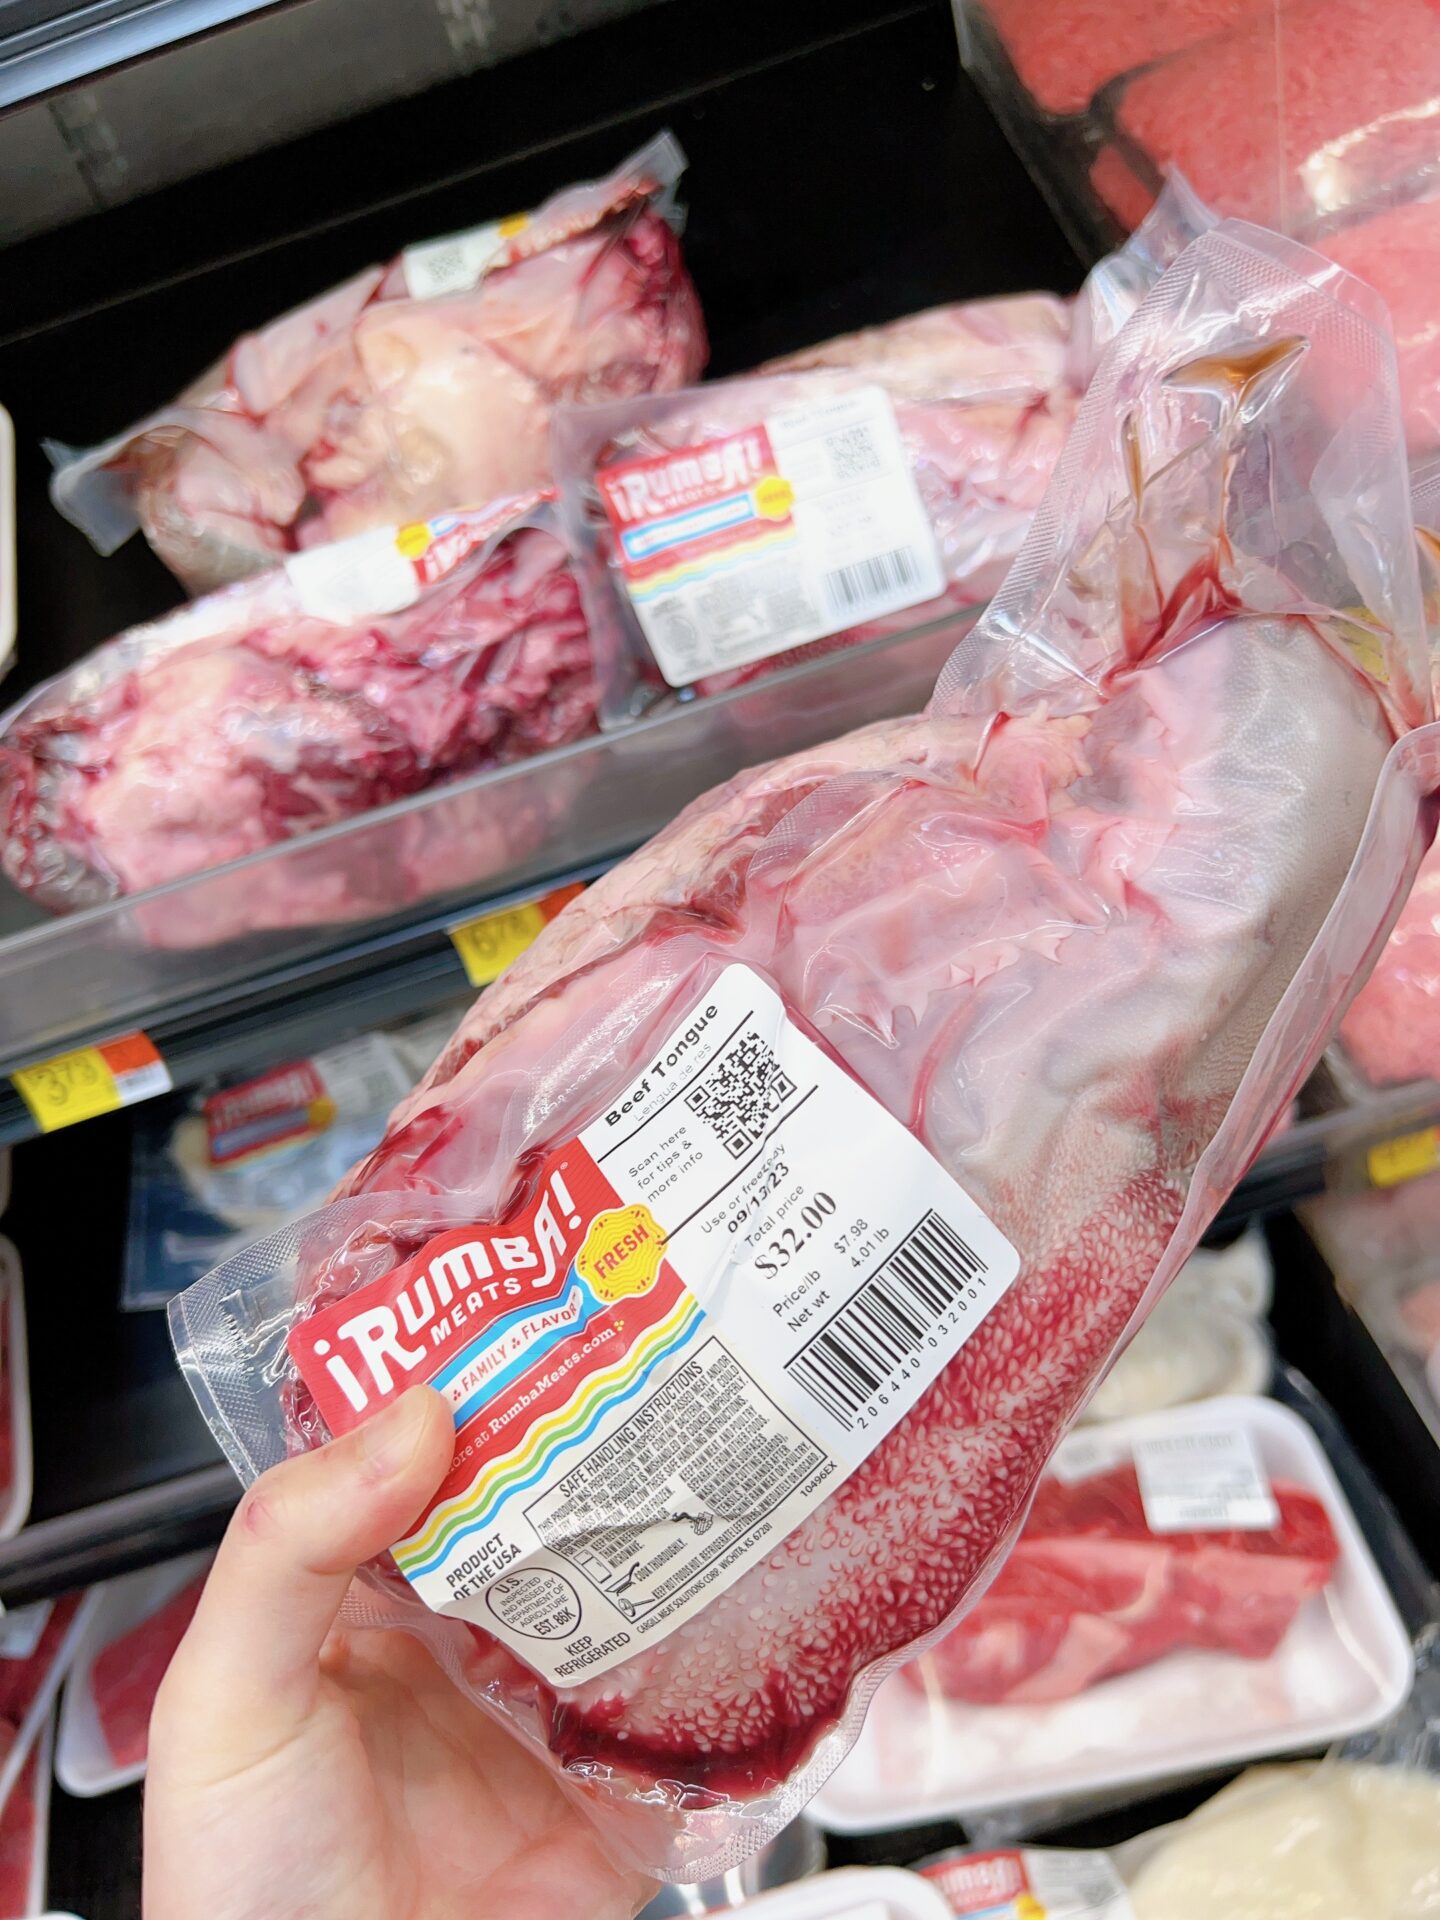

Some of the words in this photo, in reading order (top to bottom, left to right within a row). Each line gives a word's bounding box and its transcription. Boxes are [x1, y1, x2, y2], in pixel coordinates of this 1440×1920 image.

[603, 1079, 653, 1127] Beef
[650, 1003, 719, 1076] Tongue
[633, 1079, 679, 1122] Lengua
[676, 1062, 694, 1082] de
[691, 1042, 712, 1064] res
[627, 1148, 659, 1178] Scan
[658, 1124, 687, 1151] here
[636, 1170, 656, 1189] for
[655, 1148, 681, 1174] tips
[680, 1138, 693, 1150] &
[646, 1172, 679, 1202] more
[677, 1148, 704, 1174] info
[700, 1209, 727, 1235] Use
[727, 1194, 742, 1211] or
[744, 1214, 776, 1248] Total
[774, 1183, 805, 1220] price
[752, 1187, 839, 1282] $32.00
[592, 1222, 651, 1279] FRESH
[771, 1267, 822, 1318] Price/lb
[832, 1216, 869, 1255] $7.98
[787, 1304, 813, 1333] Net
[811, 1288, 831, 1309] wt
[848, 1238, 876, 1269] 4.01
[874, 1225, 890, 1243] lb
[428, 1278, 518, 1346] MEATS
[459, 1343, 511, 1392] FAMILY
[519, 1303, 578, 1339] FLAVOR
[441, 1442, 474, 1474] ore
[471, 1428, 490, 1449] at
[486, 1324, 616, 1435] RumbaMeats.com
[558, 1468, 588, 1498] SAFE
[583, 1425, 637, 1476] HANDLING
[631, 1359, 703, 1432] INSTRUCTIONS
[537, 1517, 554, 1534] THIS
[550, 1496, 579, 1523] PRODUCT
[574, 1486, 592, 1503] WAS
[587, 1462, 620, 1492] PREPARED
[615, 1447, 636, 1468] FROM
[631, 1419, 665, 1453] INSPECTED
[660, 1409, 675, 1426] AND
[671, 1389, 695, 1415] PASSED
[690, 1374, 710, 1396] MEAT
[706, 1353, 731, 1381] AND/OR
[573, 1501, 593, 1521] SOME
[590, 1487, 610, 1507] FOOD
[606, 1461, 640, 1493] PRODUCTS
[637, 1447, 654, 1465] MAY
[651, 1424, 677, 1452] CONTAIN
[674, 1399, 704, 1429] BACTERIA
[701, 1384, 719, 1404] THAT
[716, 1364, 739, 1388] COULD
[573, 1533, 591, 1550] YOUR
[624, 1486, 650, 1512] FOLLOW
[646, 1471, 666, 1492] THESE
[663, 1458, 681, 1477] SAFE
[676, 1432, 708, 1464] HANDLING
[703, 1392, 748, 1438] INSTRUCTIONS.
[593, 1509, 604, 1521] IF
[600, 1499, 615, 1514] THE
[612, 1477, 641, 1505] PRODUCT
[637, 1471, 648, 1483] IS
[644, 1439, 681, 1476] MISHANDLED
[677, 1430, 689, 1445] OR
[685, 1409, 712, 1437] COOKED
[707, 1374, 748, 1416] IMPROPERLY.
[678, 1463, 696, 1482] KEEP
[691, 1452, 708, 1470] RAW
[703, 1439, 722, 1459] MEAT
[719, 1427, 734, 1444] AND
[729, 1404, 758, 1434] POULTRY
[686, 1461, 717, 1493] SEPARATE
[712, 1447, 732, 1468] FROM
[727, 1431, 749, 1454] OTHER
[745, 1411, 770, 1437] FOODS.
[695, 1480, 716, 1501] WASH
[711, 1457, 740, 1486] WORKING
[735, 1431, 767, 1464] SURFACES
[735, 1454, 762, 1482] CUTTING
[741, 1476, 756, 1493] AND
[752, 1459, 774, 1482] HANDS
[769, 1443, 790, 1465] AFTER
[748, 1484, 765, 1502] RAW
[760, 1471, 779, 1491] MEAT
[774, 1463, 787, 1477] OR
[782, 1439, 811, 1469] POULTRY.
[799, 1460, 838, 1498] 10496EX
[590, 1537, 607, 1552] KEEP
[640, 1504, 652, 1517] OR
[649, 1483, 675, 1510] FROZEN.
[652, 1584, 667, 1600] KEEP
[663, 1576, 677, 1591] HOT
[672, 1564, 692, 1583] FOODS
[699, 1527, 735, 1561] REFRIGERATE
[788, 1471, 799, 1484] OR
[794, 1449, 821, 1478] DISCARD.
[445, 1532, 507, 1588] PRODUCT
[452, 1583, 473, 1602] OF
[467, 1564, 496, 1591] THE
[491, 1541, 522, 1571] USA
[599, 1543, 618, 1560] THAW
[608, 1538, 645, 1569] MICROWAVE.
[634, 1564, 653, 1582] COOK
[648, 1536, 687, 1571] THOROUGHLY.
[636, 1613, 661, 1635] CARGILL
[657, 1602, 675, 1619] MEAT
[671, 1578, 706, 1608] SOLUTIONS
[702, 1565, 722, 1584] CORP.
[719, 1544, 747, 1569] WICHITA,
[743, 1536, 754, 1548] KS
[752, 1521, 772, 1541] 67201
[494, 1572, 524, 1597] U.S.
[500, 1575, 541, 1607] INSPECTED
[501, 1603, 518, 1617] AND
[516, 1584, 546, 1608] PASSED
[544, 1577, 557, 1589] BY
[506, 1591, 555, 1624] DEPARTMENT
[552, 1582, 566, 1595] OF
[519, 1593, 569, 1628] AGRICULTURE
[533, 1615, 558, 1637] EST.
[552, 1605, 576, 1626] 86K
[564, 1634, 595, 1657] KEEP
[553, 1629, 632, 1678] REFRIGERATED
